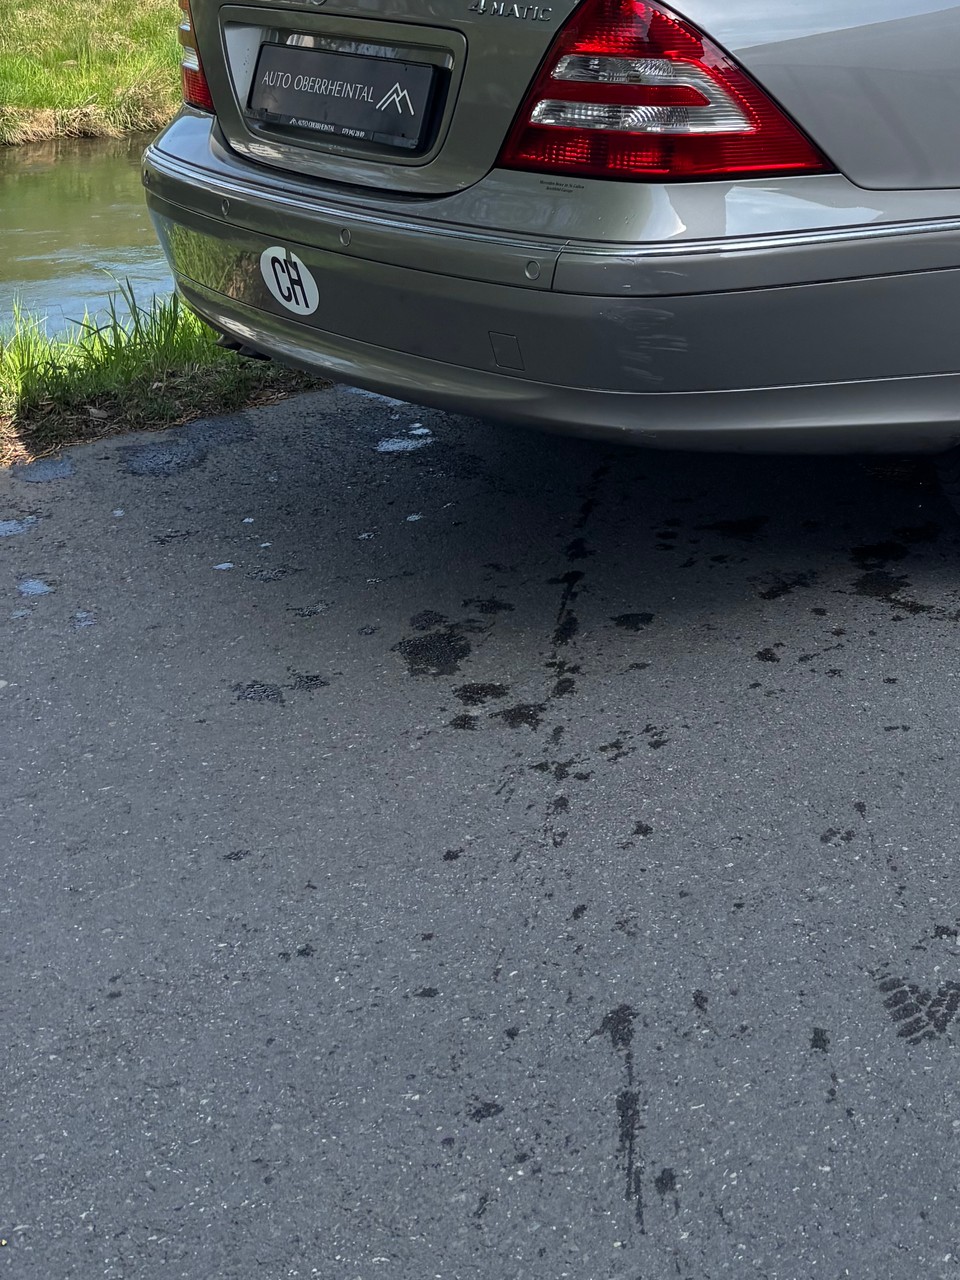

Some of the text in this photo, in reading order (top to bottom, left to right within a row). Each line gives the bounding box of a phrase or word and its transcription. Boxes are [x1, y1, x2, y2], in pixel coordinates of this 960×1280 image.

[261, 71, 374, 103] AUTO OBERRHEINTAL
[270, 256, 310, 309] CH
